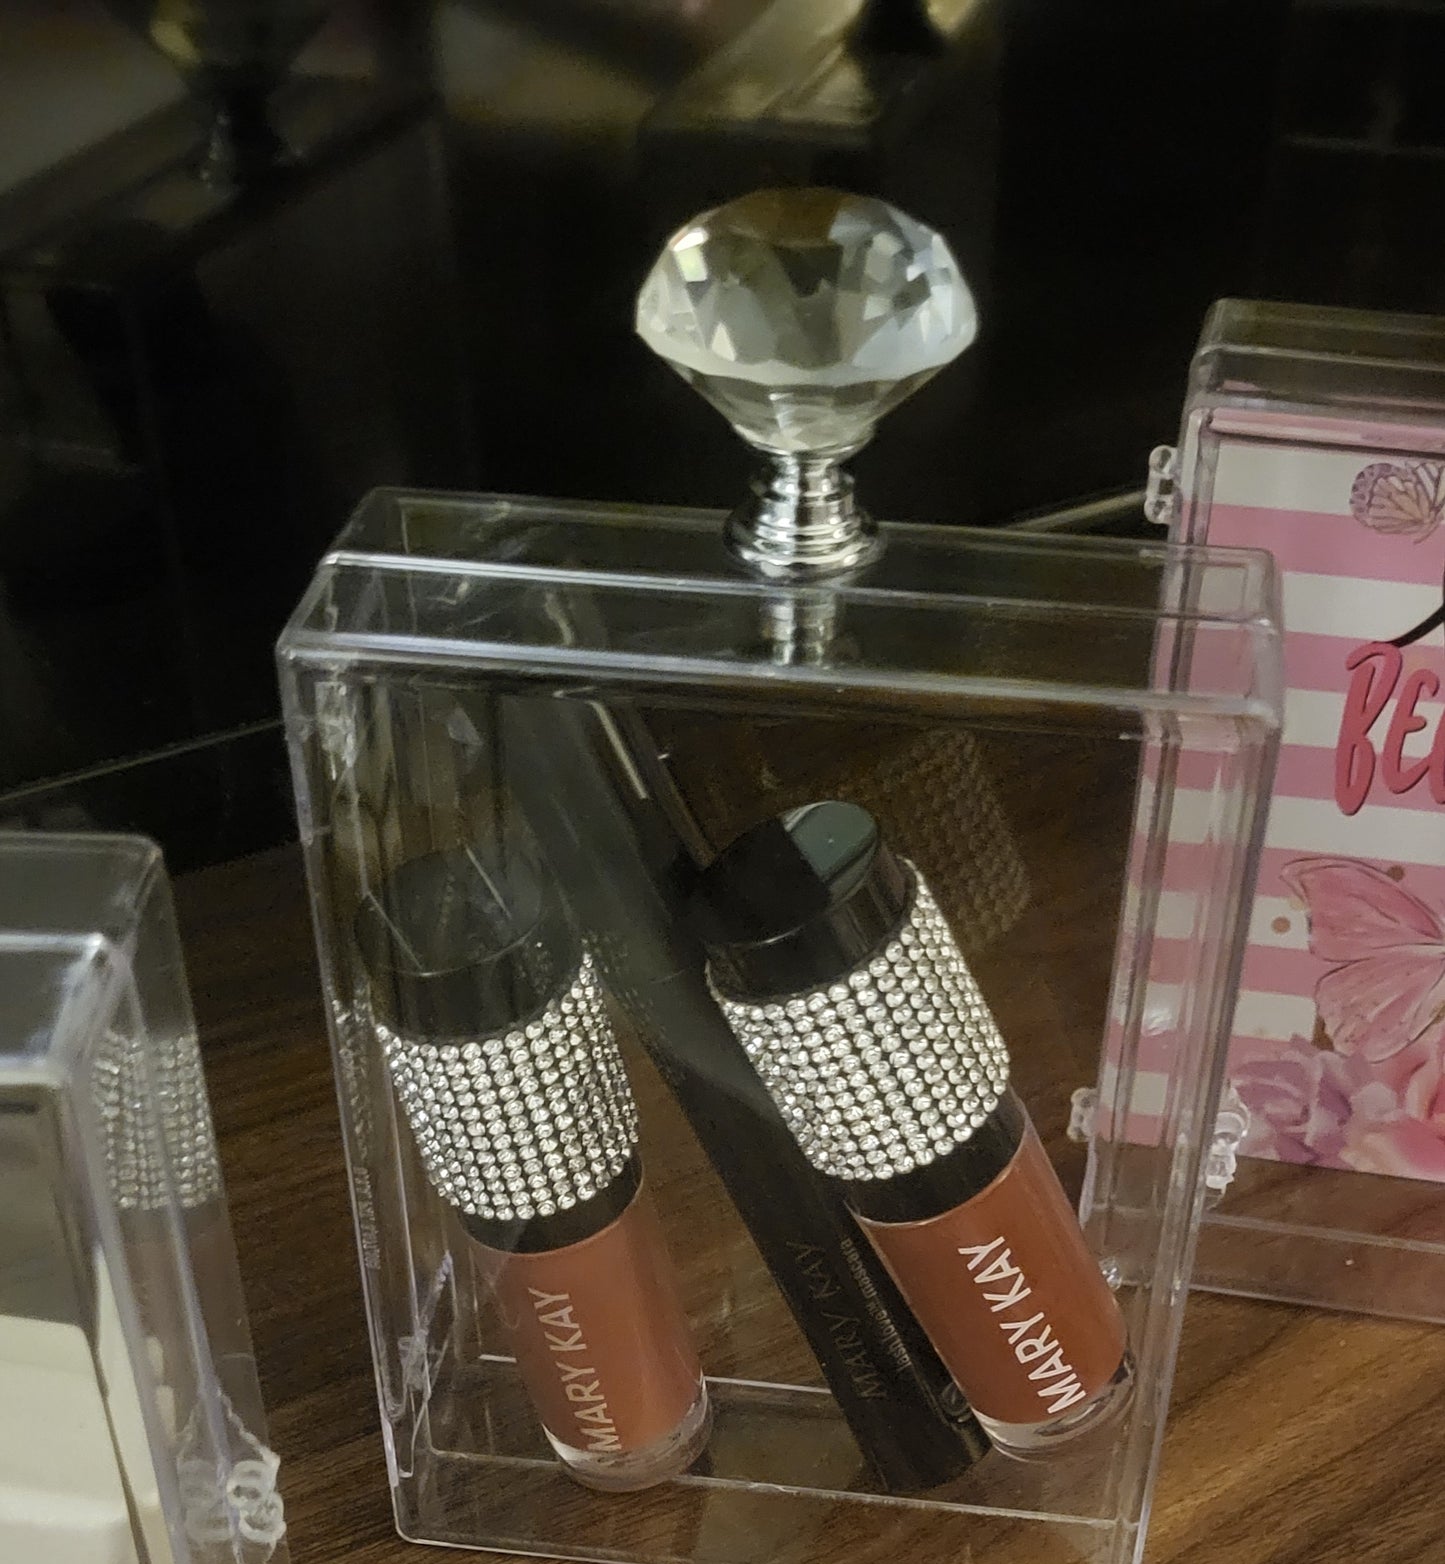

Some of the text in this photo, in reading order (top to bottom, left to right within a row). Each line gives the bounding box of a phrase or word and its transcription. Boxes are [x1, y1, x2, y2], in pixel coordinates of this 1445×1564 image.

[1335, 640, 1445, 816] BE
[785, 1240, 887, 1400] MARY KAY
[840, 1237, 878, 1299] mascara
[957, 1235, 1087, 1414] MARY KAY
[527, 1286, 623, 1452] MARY KAY
[889, 1336, 913, 1371] lash
